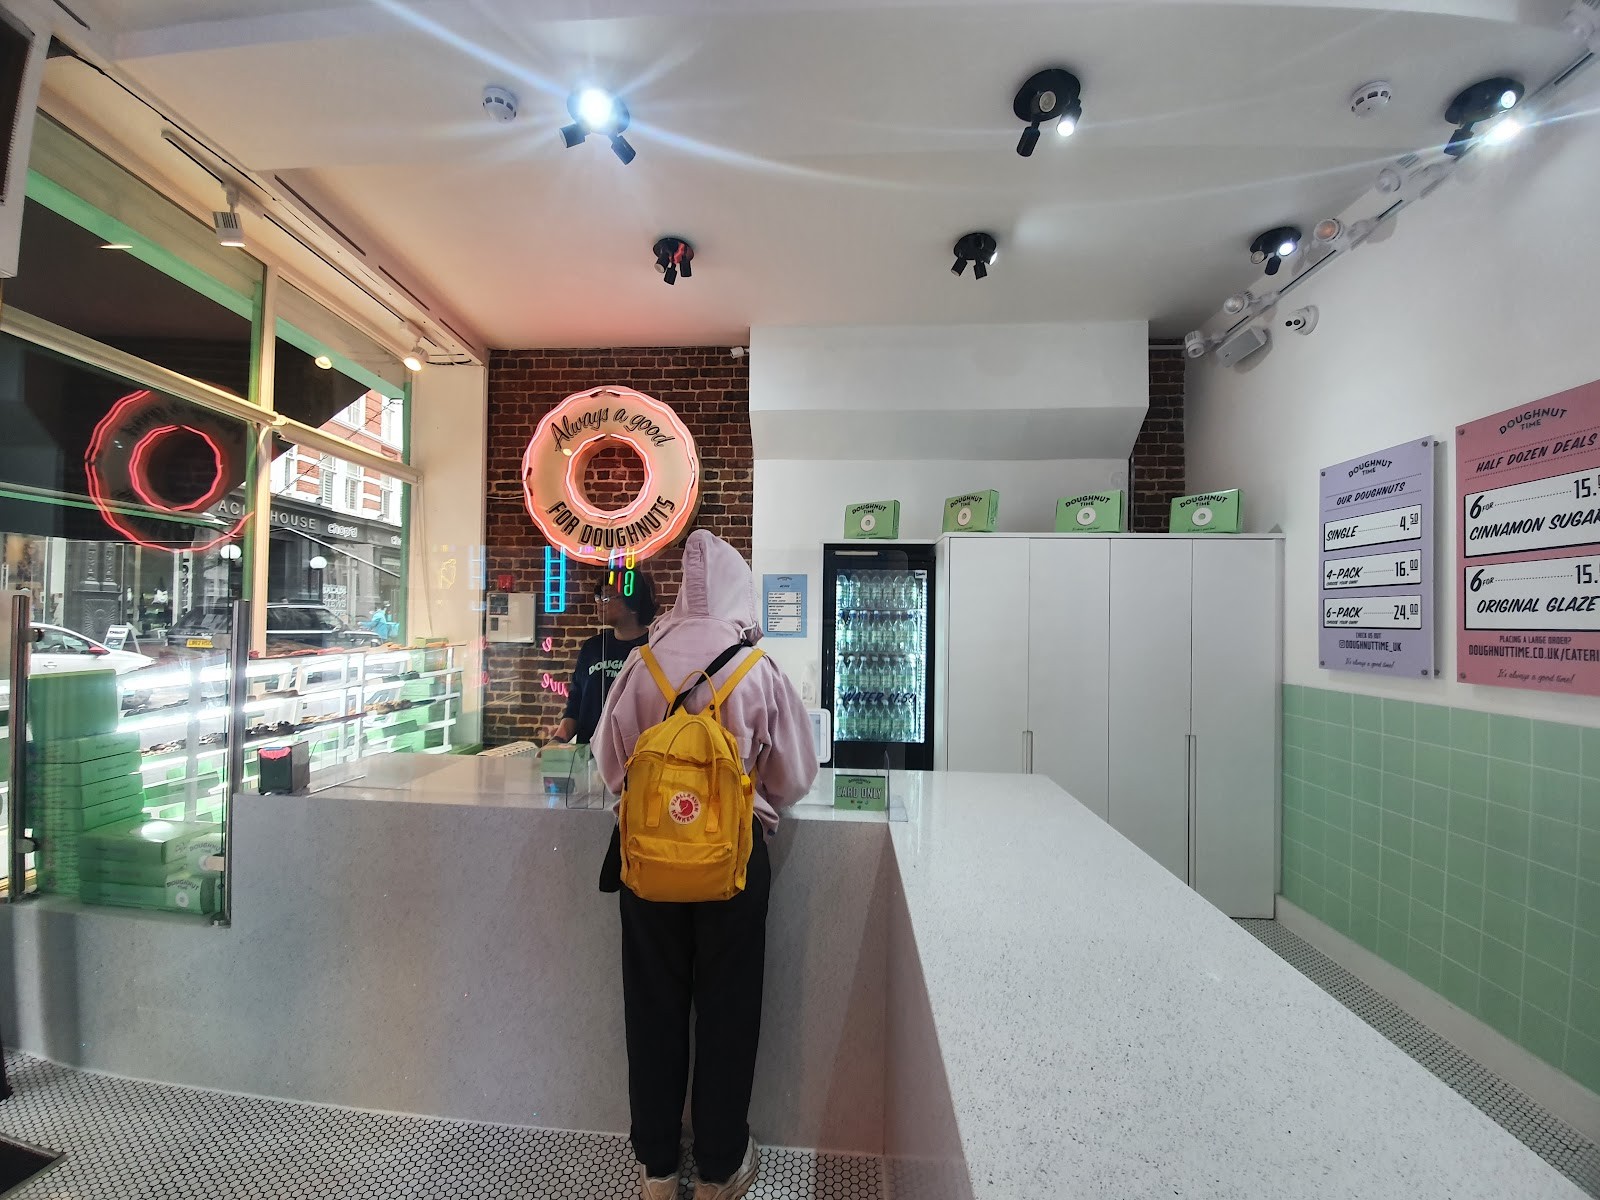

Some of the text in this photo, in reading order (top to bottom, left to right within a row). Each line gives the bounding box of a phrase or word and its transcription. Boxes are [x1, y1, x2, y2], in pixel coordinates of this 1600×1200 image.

[1499, 407, 1567, 435] DOUGHNUT
[1521, 419, 1541, 430] TIME
[550, 407, 676, 450] Always a good
[1476, 433, 1598, 473] HALF DOZEN DEALS
[1348, 459, 1392, 478] DOUGHNUT
[1362, 467, 1376, 476] TIME
[1336, 481, 1406, 506] OUR DOUGHNUTS
[950, 495, 982, 508] DOUGHNUT
[1065, 495, 1111, 507] DOUGHNUT
[1180, 495, 1228, 508] DOUGHNUT
[1469, 495, 1484, 519] 6
[1482, 501, 1494, 512] FOR
[852, 503, 887, 514] DOUGHNUT
[270, 510, 316, 530] HOUSE
[546, 495, 676, 549] FOR DOUGHNUTS
[1326, 525, 1359, 541] SINGLE
[1469, 516, 1545, 541] CINNAMON
[1326, 566, 1363, 580] 4-PACK
[1470, 568, 1485, 592] 6
[1482, 577, 1494, 586] FOR
[1326, 606, 1363, 618] 6-PACK
[1477, 598, 1540, 613] ORIGINAL
[1499, 635, 1521, 643] PLACING
[1528, 636, 1547, 644] LARGE
[1548, 637, 1572, 645] ORDER?
[1509, 671, 1530, 682] always
[1537, 674, 1555, 683] good
[843, 690, 884, 702] WATER
[861, 787, 882, 799] ONLY
[166, 879, 199, 890] DOUGHNUT
